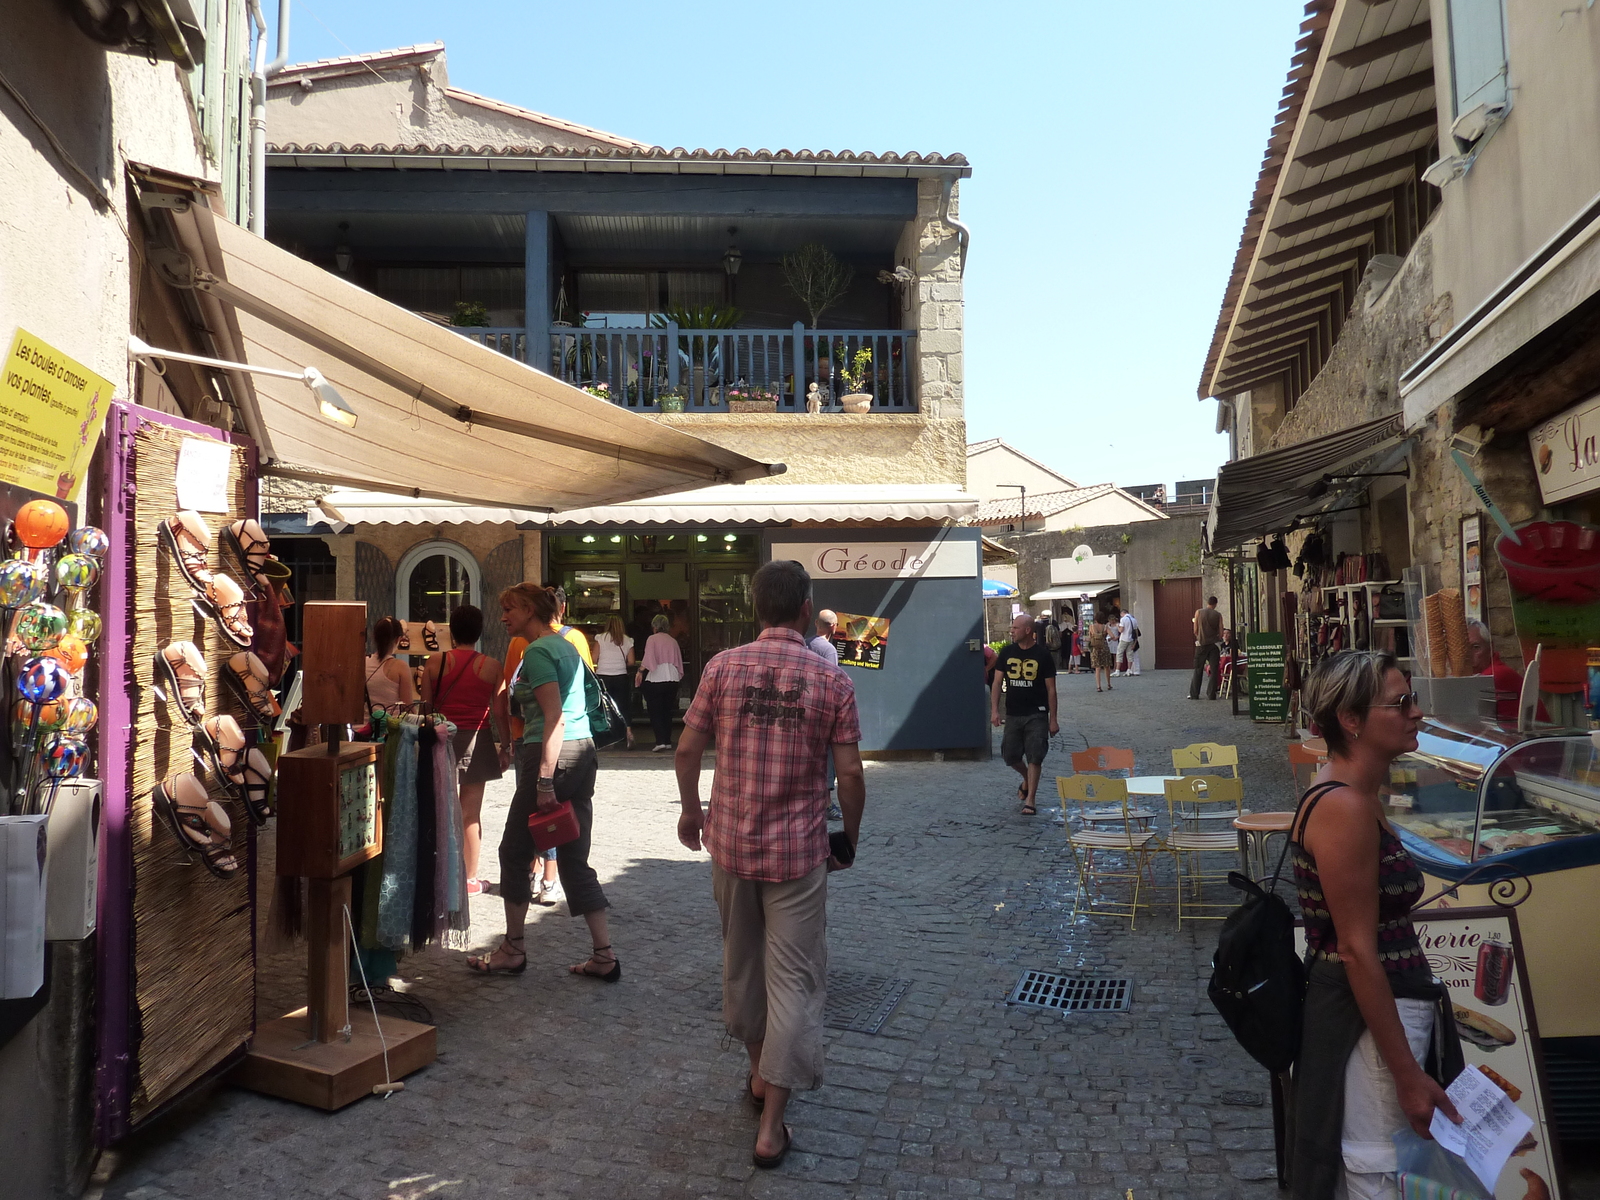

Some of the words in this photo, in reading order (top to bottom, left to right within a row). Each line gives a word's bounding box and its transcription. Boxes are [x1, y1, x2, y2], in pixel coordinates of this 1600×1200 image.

[15, 339, 31, 361] Les
[30, 347, 57, 376] boules
[57, 359, 66, 379] à
[63, 369, 88, 392] arroser
[7, 371, 22, 390] vos
[20, 378, 51, 404] plantes
[1564, 414, 1598, 472] La
[1473, 483, 1494, 509] Aguas
[817, 547, 924, 574] Géode
[1007, 657, 1039, 681] 38
[1010, 680, 1034, 688] FRANKLIN
